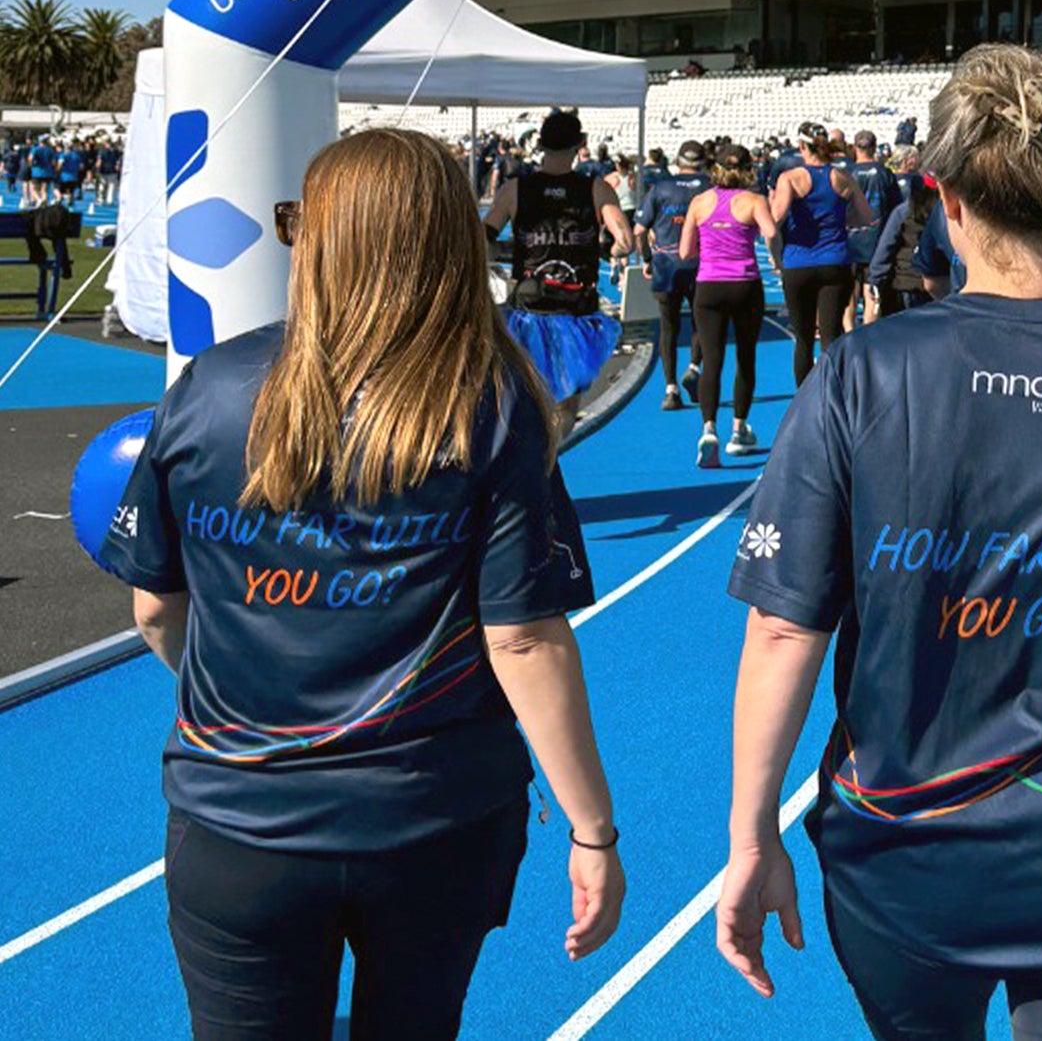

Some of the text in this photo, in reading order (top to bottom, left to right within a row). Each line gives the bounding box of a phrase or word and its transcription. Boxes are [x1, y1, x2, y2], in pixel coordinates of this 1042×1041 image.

[186, 500, 472, 551] HOW FAR WILL
[868, 524, 970, 573] HOW
[244, 565, 408, 608] YOU GO?
[938, 596, 1018, 640] YOU
